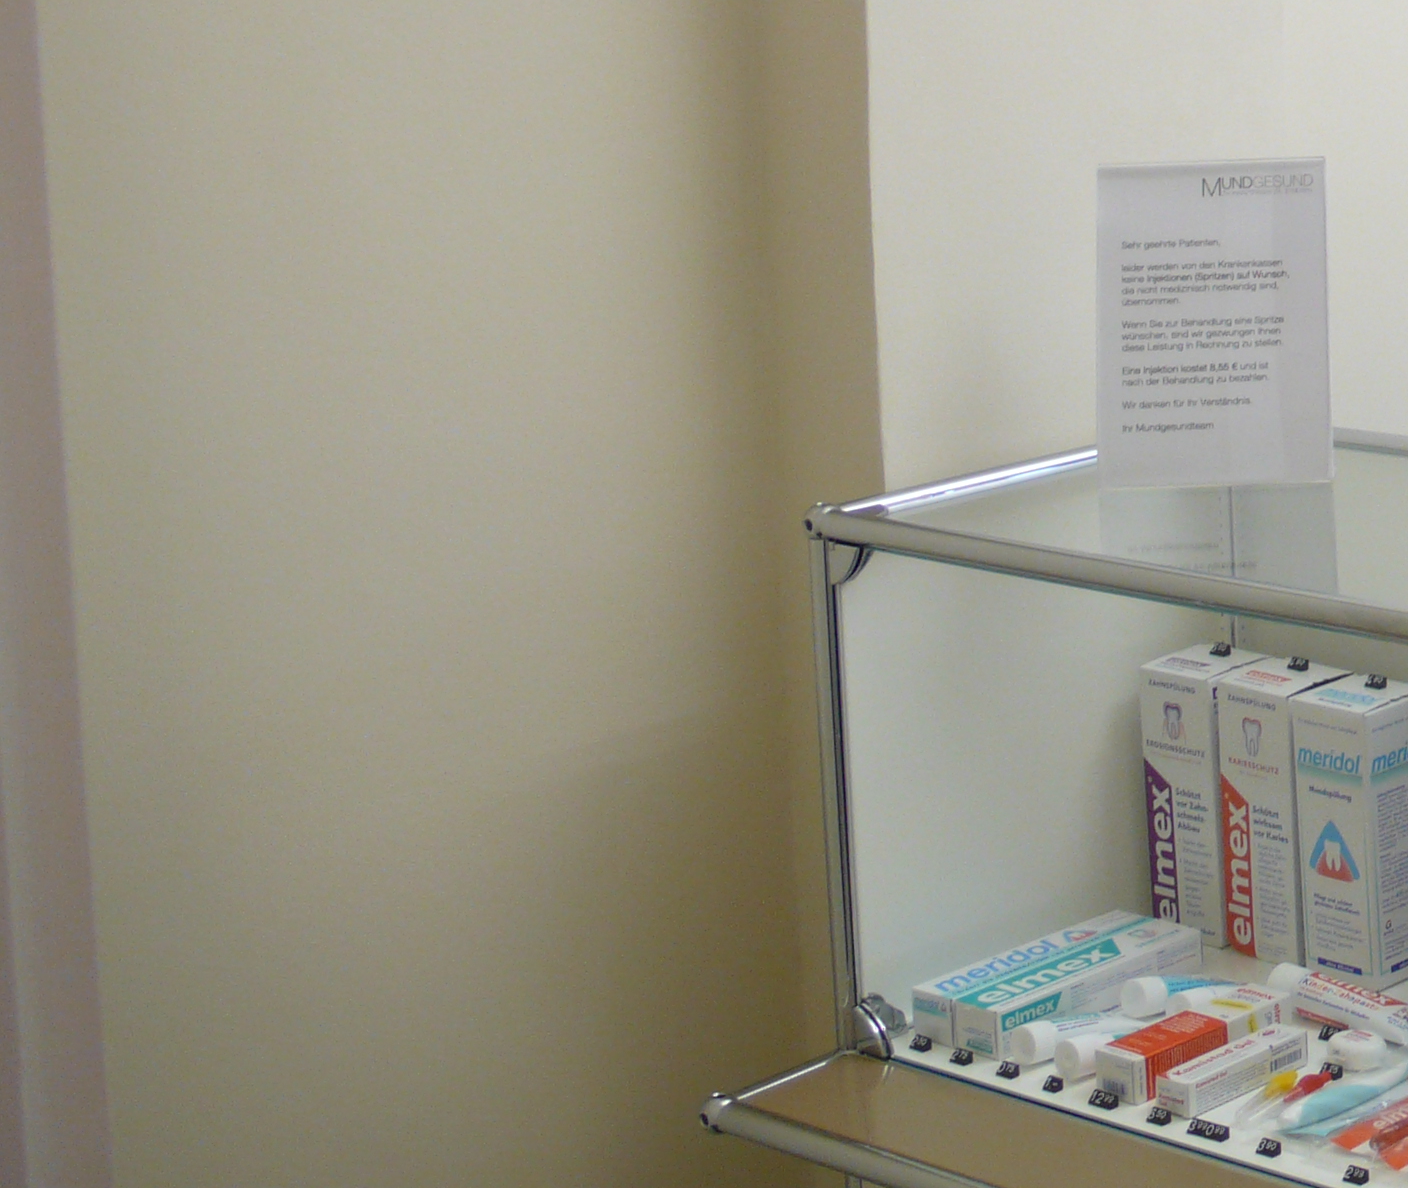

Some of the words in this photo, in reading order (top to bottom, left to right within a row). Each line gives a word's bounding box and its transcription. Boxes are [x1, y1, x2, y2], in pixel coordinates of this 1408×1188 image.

[1202, 173, 1314, 197] MUNDGESUND
[1121, 240, 1142, 250] Sehr
[1147, 262, 1178, 271] werden
[1194, 271, 1234, 283] (Spritzen)
[1252, 270, 1290, 280] Wunsch,
[1121, 286, 1135, 295] die
[1137, 285, 1158, 294] nicht
[1160, 284, 1210, 293] medizinisch
[1212, 282, 1256, 293] notwendig
[1121, 297, 1181, 306] übernommen.
[1121, 320, 1147, 329] Wenn
[1149, 319, 1163, 328] Sie
[1165, 319, 1178, 327] zur
[1180, 317, 1232, 327] Behandlung
[1234, 316, 1252, 325] eine
[1254, 316, 1284, 326] Spritze
[1171, 330, 1189, 339] sind
[1191, 329, 1204, 338] wir
[1206, 328, 1256, 339] gezwungen
[1257, 327, 1281, 335] Ihnen
[1121, 343, 1145, 352] diese
[1147, 342, 1184, 352] Leistung
[1185, 341, 1194, 350] in
[1196, 340, 1240, 350] Rechnung
[1242, 340, 1252, 348] zu
[1121, 366, 1141, 376] Eine
[1143, 365, 1179, 376] Injektion
[1180, 363, 1208, 373] kostet
[1232, 362, 1239, 370] €
[1240, 362, 1257, 370] und
[1258, 361, 1269, 370] ist
[1121, 378, 1144, 387] nach
[1145, 377, 1160, 386] der
[1162, 375, 1214, 386] Behandlung
[1216, 375, 1227, 383] zu
[1228, 373, 1269, 383] bezahlen.
[1121, 400, 1137, 409] Wir
[1138, 399, 1171, 409] danken
[1172, 398, 1185, 407] für
[1187, 397, 1198, 407] Ihr
[1121, 424, 1133, 433] Ihr
[1136, 422, 1214, 433] Mundgesundteam
[1297, 746, 1361, 775] meridol
[1152, 784, 1177, 922] elmex
[1228, 801, 1252, 946] elmex
[935, 939, 1060, 993] meridol
[977, 947, 1113, 1006] elmex
[1004, 999, 1055, 1028] elmex
